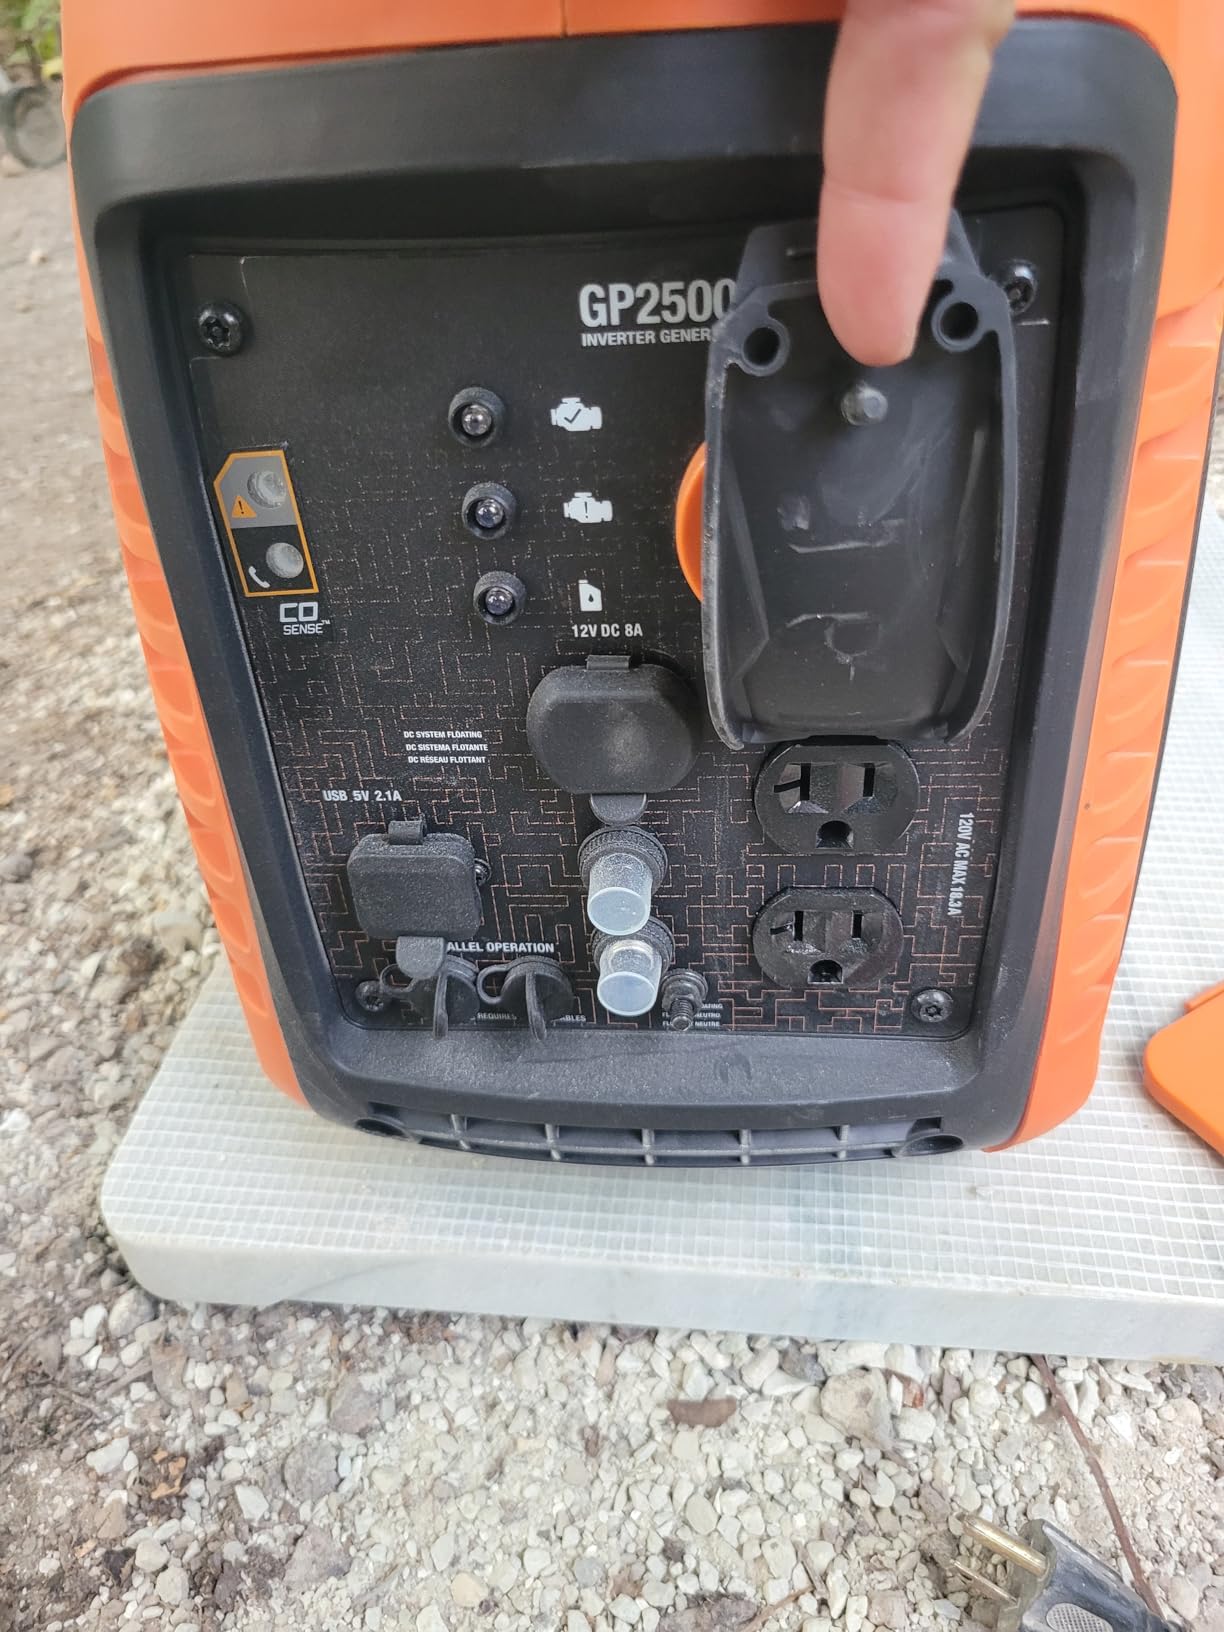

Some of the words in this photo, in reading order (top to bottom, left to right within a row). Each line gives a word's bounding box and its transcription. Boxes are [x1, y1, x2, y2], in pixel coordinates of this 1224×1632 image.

[579, 278, 738, 328] GP2500
[581, 330, 656, 347] INVERTER
[659, 327, 712, 344] GENER
[279, 601, 319, 623] CO
[571, 623, 598, 638] 12V
[600, 622, 621, 637] DC
[624, 622, 643, 637] 8A
[403, 730, 415, 739] DC
[415, 730, 446, 739] SYSTEM
[446, 730, 483, 739] FLOATING
[405, 743, 417, 752] DC
[417, 743, 451, 752] SISTEMA
[451, 743, 489, 752] FLOTANTE
[407, 755, 419, 764] DC
[449, 755, 487, 764] FLOTTANT
[322, 790, 348, 801] USB
[352, 790, 370, 801] 5V
[374, 789, 402, 801] 2.1A
[957, 811, 975, 841] 120V
[954, 842, 971, 859] AC
[951, 860, 969, 885] MAX
[446, 941, 484, 952] ALLEL
[486, 942, 555, 953] OPERATION
